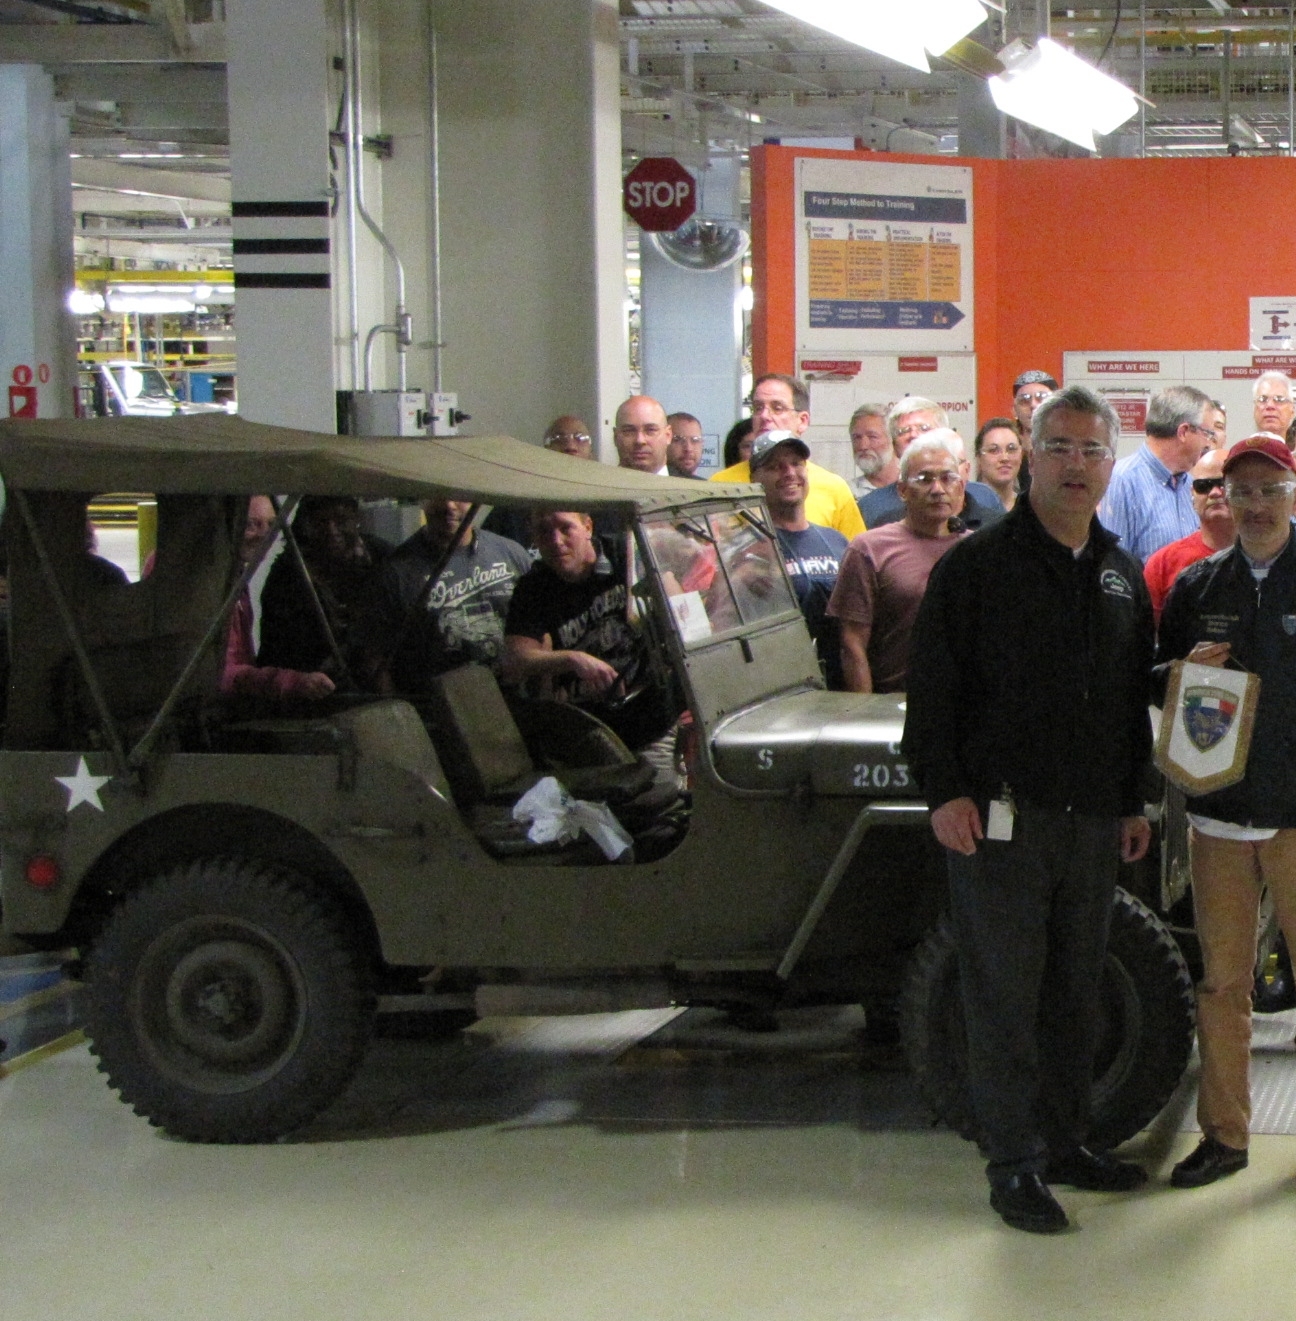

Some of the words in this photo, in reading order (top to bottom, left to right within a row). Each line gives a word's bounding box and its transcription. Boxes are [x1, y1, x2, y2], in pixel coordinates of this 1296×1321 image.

[628, 181, 690, 208] STOP
[812, 196, 830, 206] Four
[832, 197, 848, 208] Step
[850, 198, 875, 208] Method
[877, 200, 884, 208] to
[886, 200, 915, 211] Training
[1089, 363, 1107, 371] WHY
[1108, 363, 1123, 371] ARE
[1125, 363, 1138, 371] WE
[1139, 363, 1160, 371] HERE
[427, 562, 515, 609] Overland
[758, 749, 773, 770] S
[853, 763, 909, 787] 203
